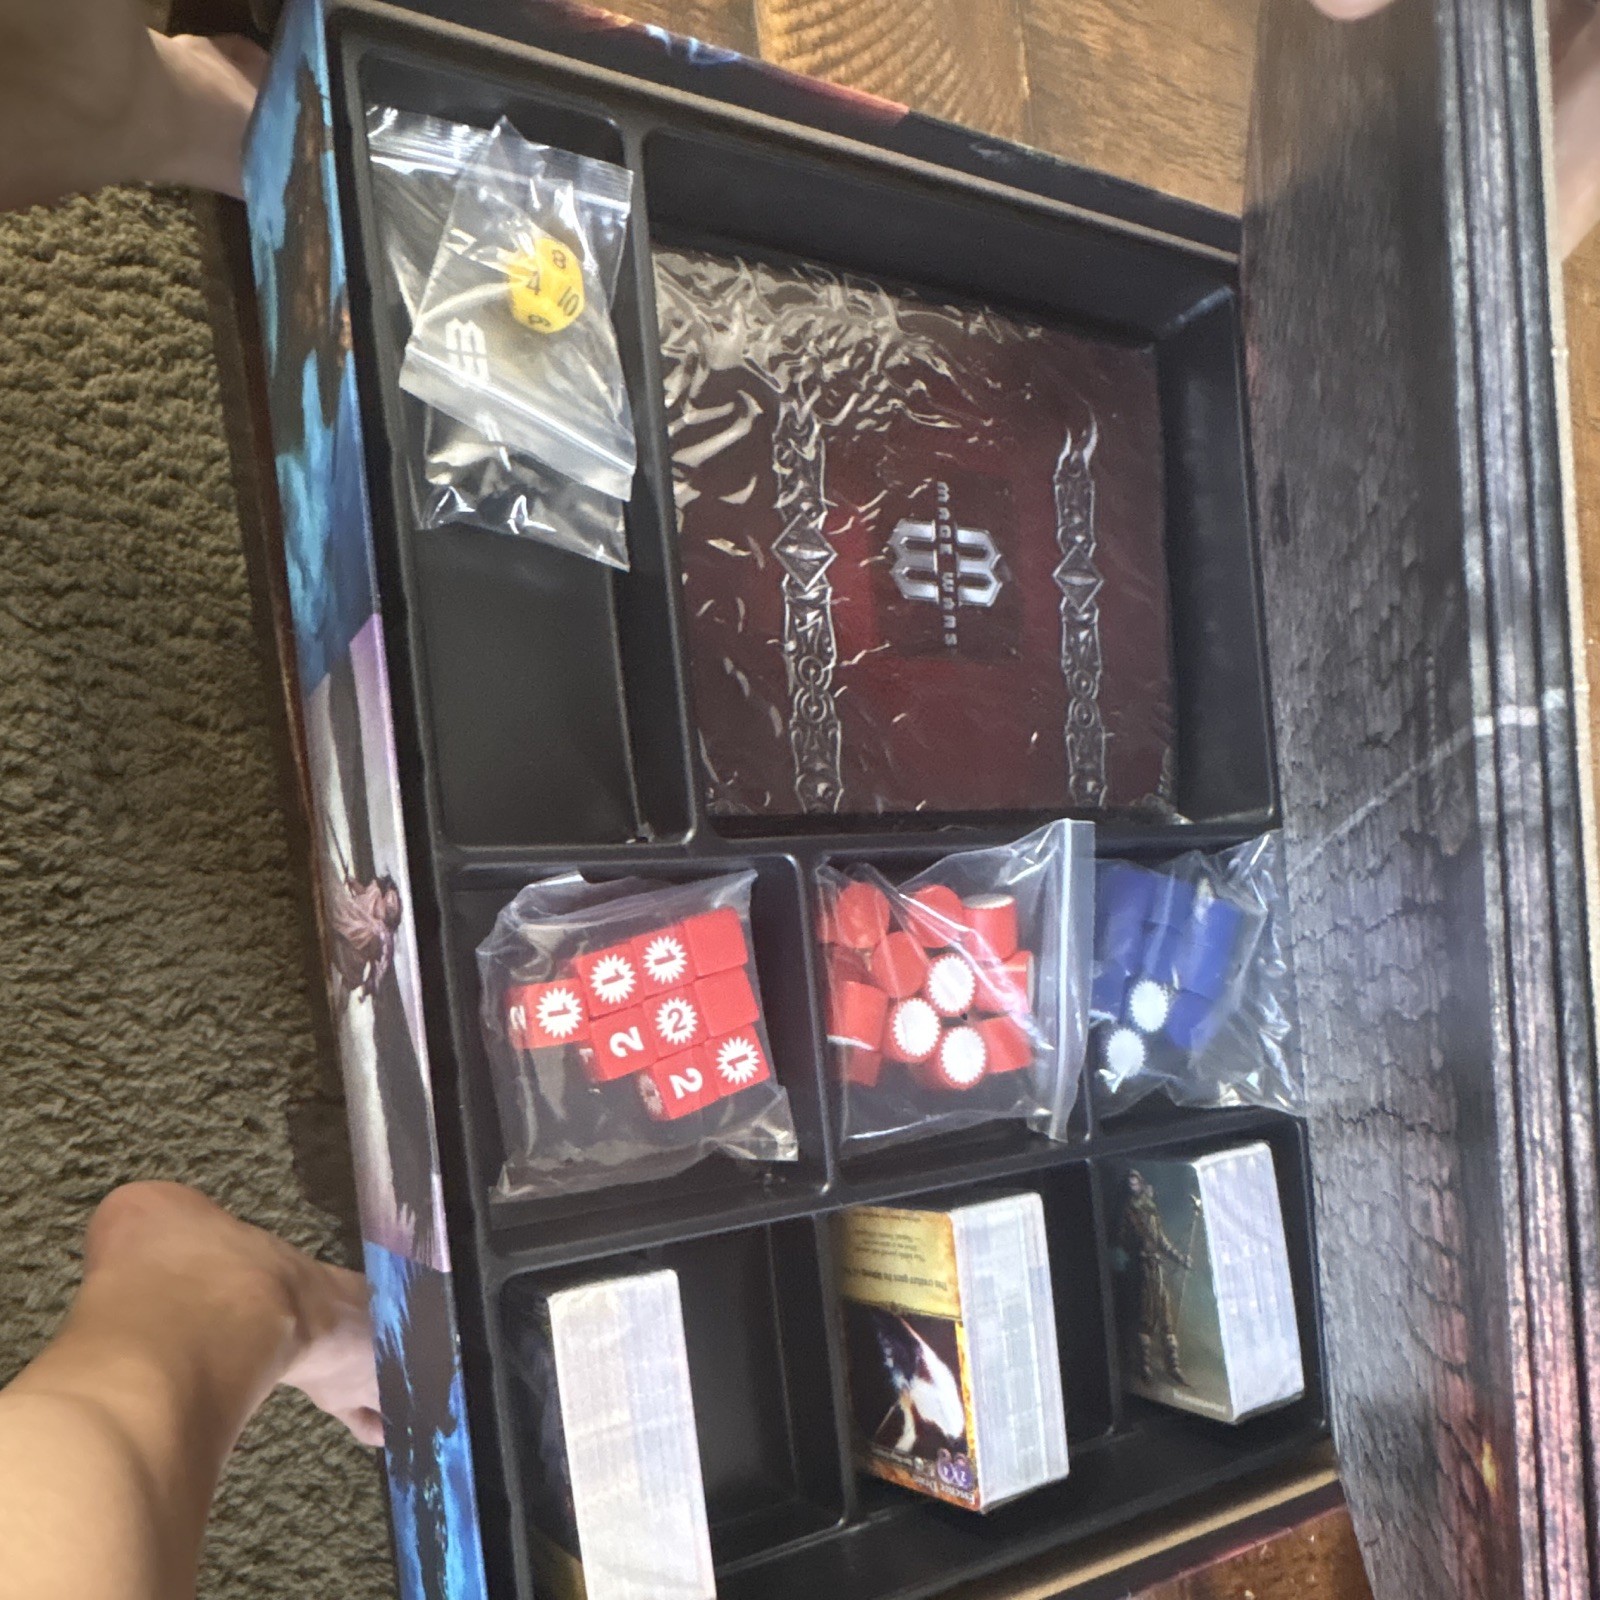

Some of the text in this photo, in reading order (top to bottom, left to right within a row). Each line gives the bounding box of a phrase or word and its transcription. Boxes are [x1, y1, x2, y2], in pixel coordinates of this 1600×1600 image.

[526, 271, 542, 296] 4
[557, 286, 580, 317] 10
[936, 481, 958, 647] MAGE WARS
[667, 1007, 687, 1032] 2
[609, 1026, 645, 1058] 2
[668, 1066, 704, 1100] 2
